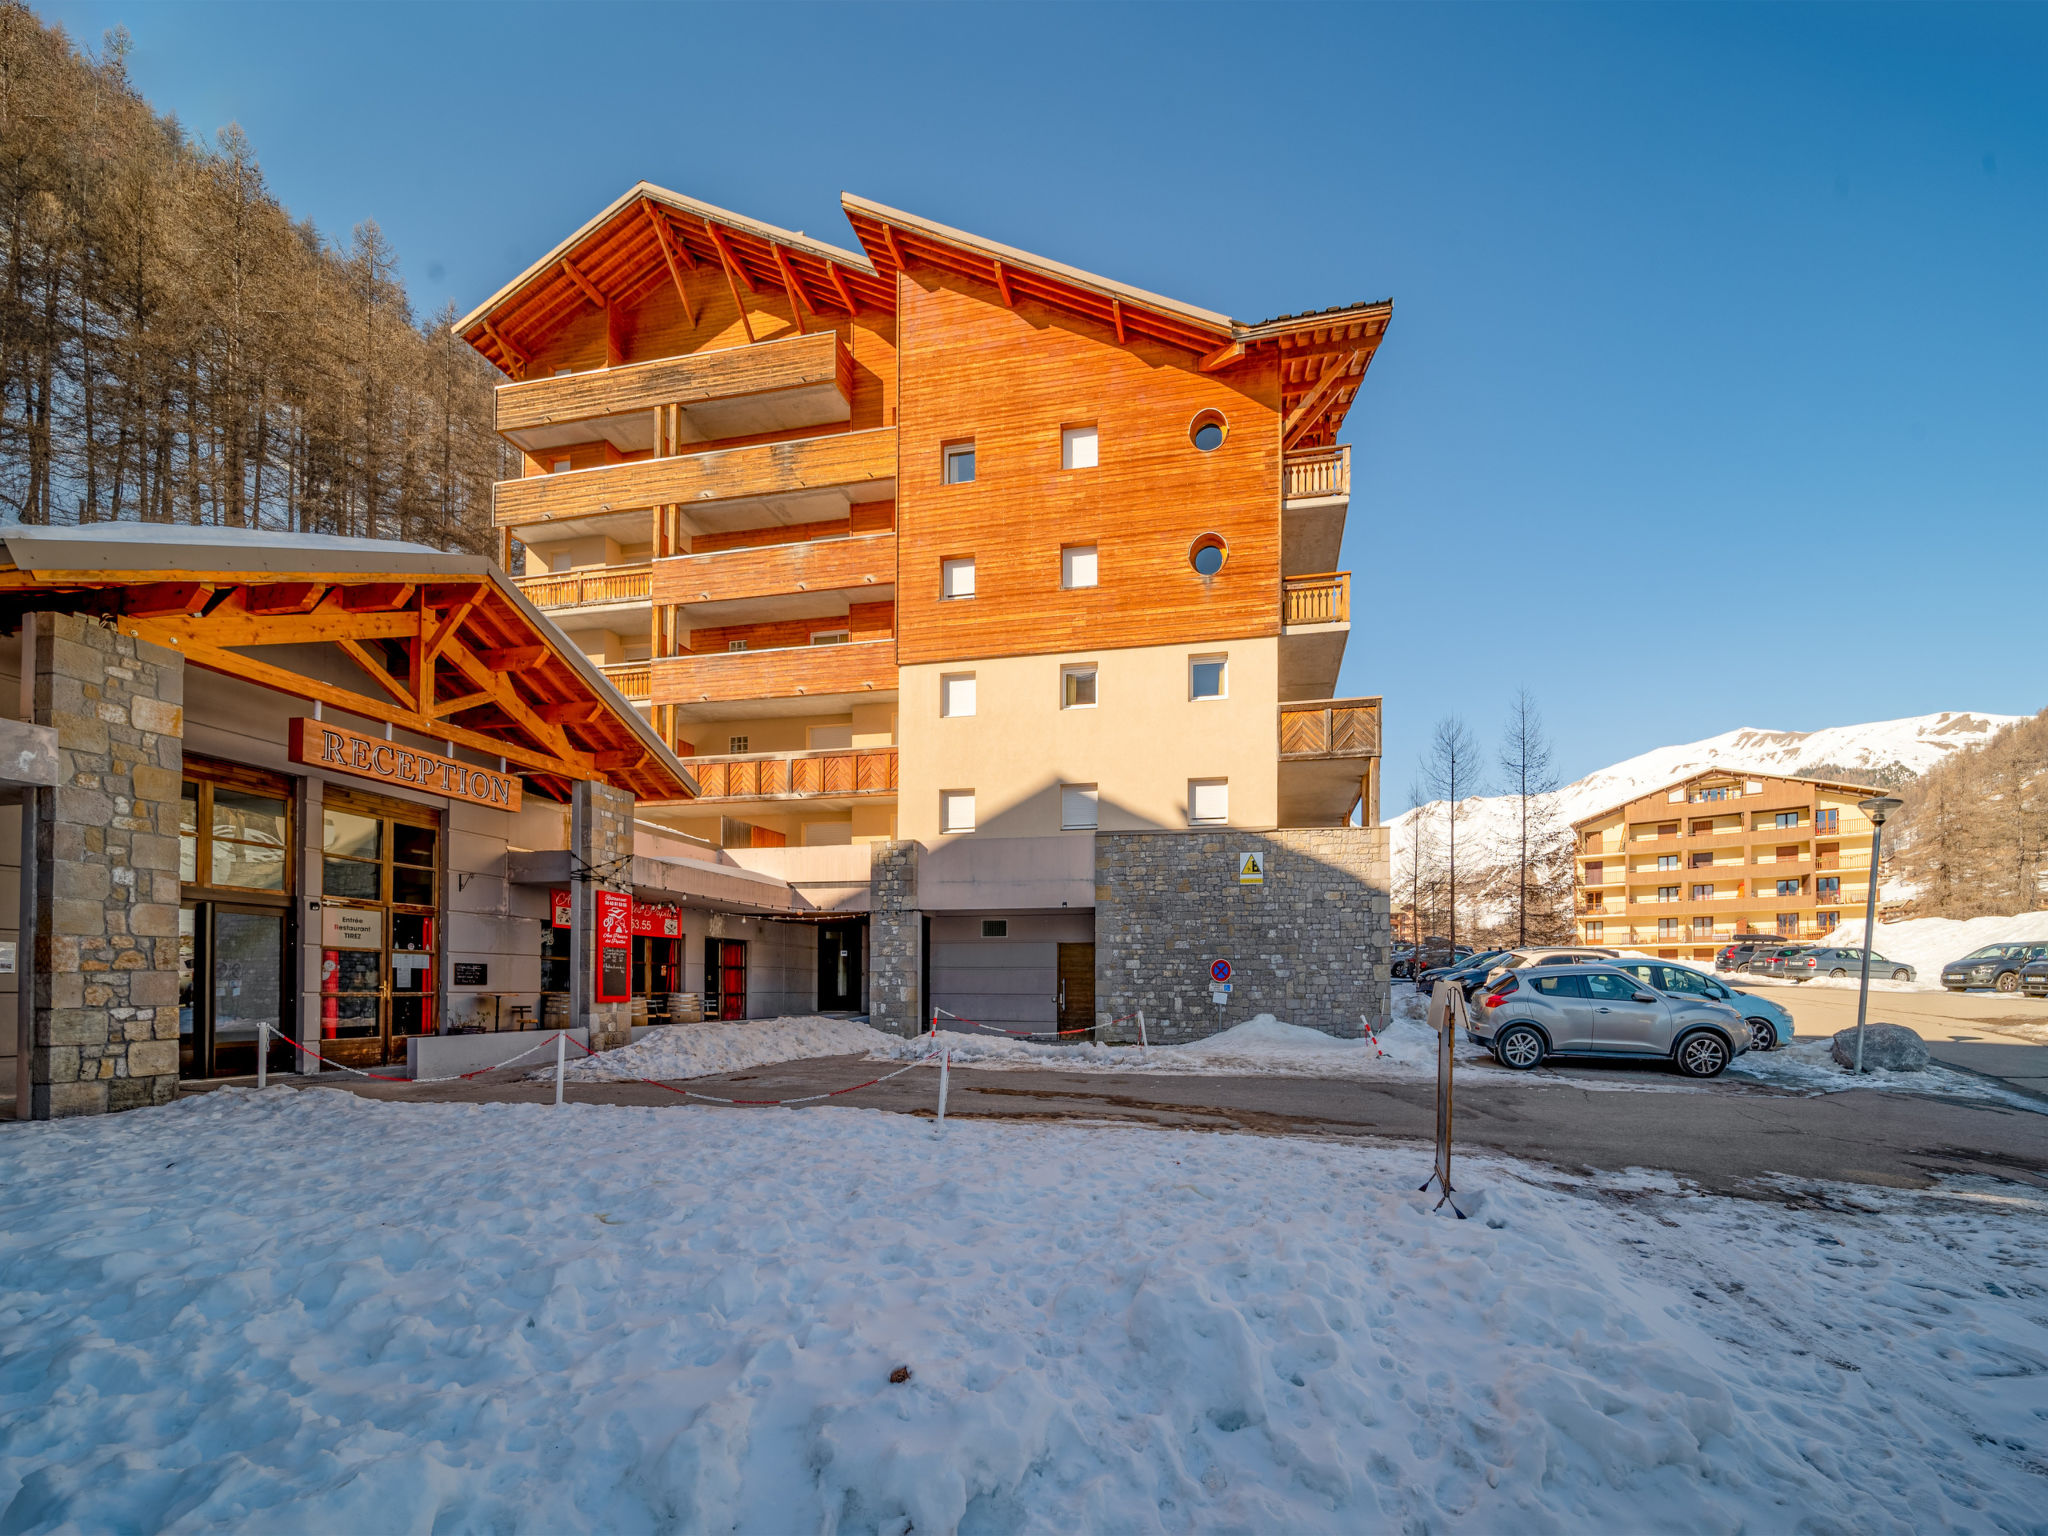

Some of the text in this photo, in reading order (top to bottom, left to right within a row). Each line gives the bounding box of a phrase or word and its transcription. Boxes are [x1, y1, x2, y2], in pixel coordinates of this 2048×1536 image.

[322, 730, 511, 805] RECEPTION
[342, 916, 364, 924] Entrée
[334, 924, 371, 932] Restaurant
